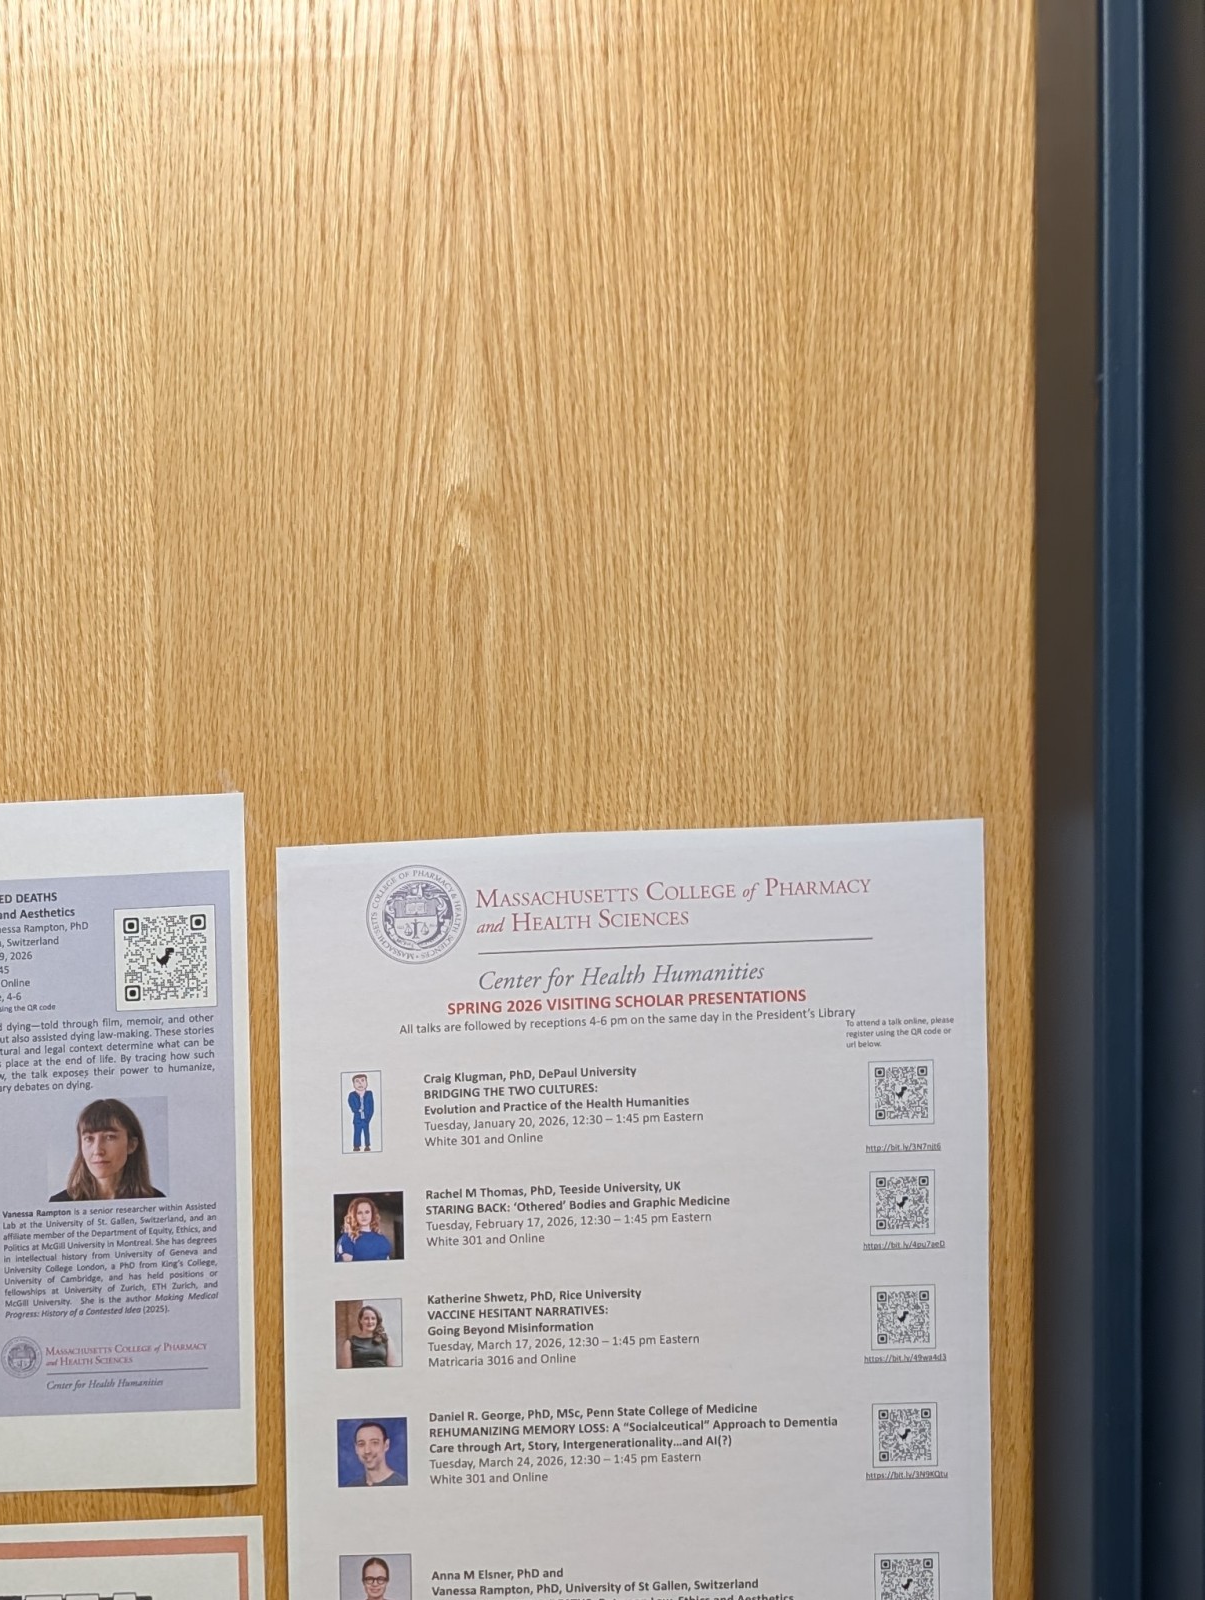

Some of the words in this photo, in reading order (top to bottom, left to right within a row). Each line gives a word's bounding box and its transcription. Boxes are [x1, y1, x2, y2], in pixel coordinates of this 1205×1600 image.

[16, 892, 57, 903] DEATHS
[476, 888, 638, 910] MASSACHUSETTS
[646, 882, 736, 900] COLLEGE
[743, 882, 759, 902] of
[765, 878, 870, 896] PHARMACY
[20, 908, 75, 918] Aesthetics
[477, 917, 505, 933] and
[512, 912, 591, 932] HEALTH
[599, 909, 688, 928] SCIENCES
[0, 952, 7, 961] 9,
[11, 951, 32, 960] 2026
[1, 979, 30, 987] Online
[479, 970, 542, 990] Center
[543, 967, 575, 994] for
[580, 963, 646, 986] Health
[653, 963, 764, 983] Humanities
[7, 992, 21, 1000] 4-6
[448, 1001, 502, 1015] SPRING
[507, 999, 542, 1012] 2026
[547, 997, 611, 1011] VISITING
[616, 994, 683, 1008] SCHOLAR
[689, 989, 806, 1005] PRESENTATIONS
[424, 1074, 451, 1085] Craig
[455, 1073, 506, 1084] Klugman,
[510, 1070, 535, 1080] PhD,
[539, 1068, 577, 1078] DePaul
[581, 1066, 636, 1077] University
[424, 1088, 480, 1099] BRIDGING
[483, 1087, 504, 1096] THE
[508, 1086, 535, 1096] TWO
[539, 1083, 597, 1094] CULTURES:
[426, 1189, 462, 1199] Rachel
[466, 1188, 476, 1197] M
[480, 1188, 527, 1197] Thomas,
[531, 1186, 556, 1196] PhD,
[559, 1184, 600, 1194] Teeside
[604, 1182, 661, 1193] University,
[665, 1181, 680, 1191] UK
[428, 1294, 481, 1304] Katherine
[484, 1293, 527, 1302] Shwetz,
[531, 1291, 555, 1302] PhD,
[560, 1291, 582, 1300] Rice
[586, 1289, 641, 1299] University
[428, 1309, 475, 1320] VACCINE
[479, 1308, 532, 1318] HESITANT
[536, 1305, 609, 1316] NARRATIVES:
